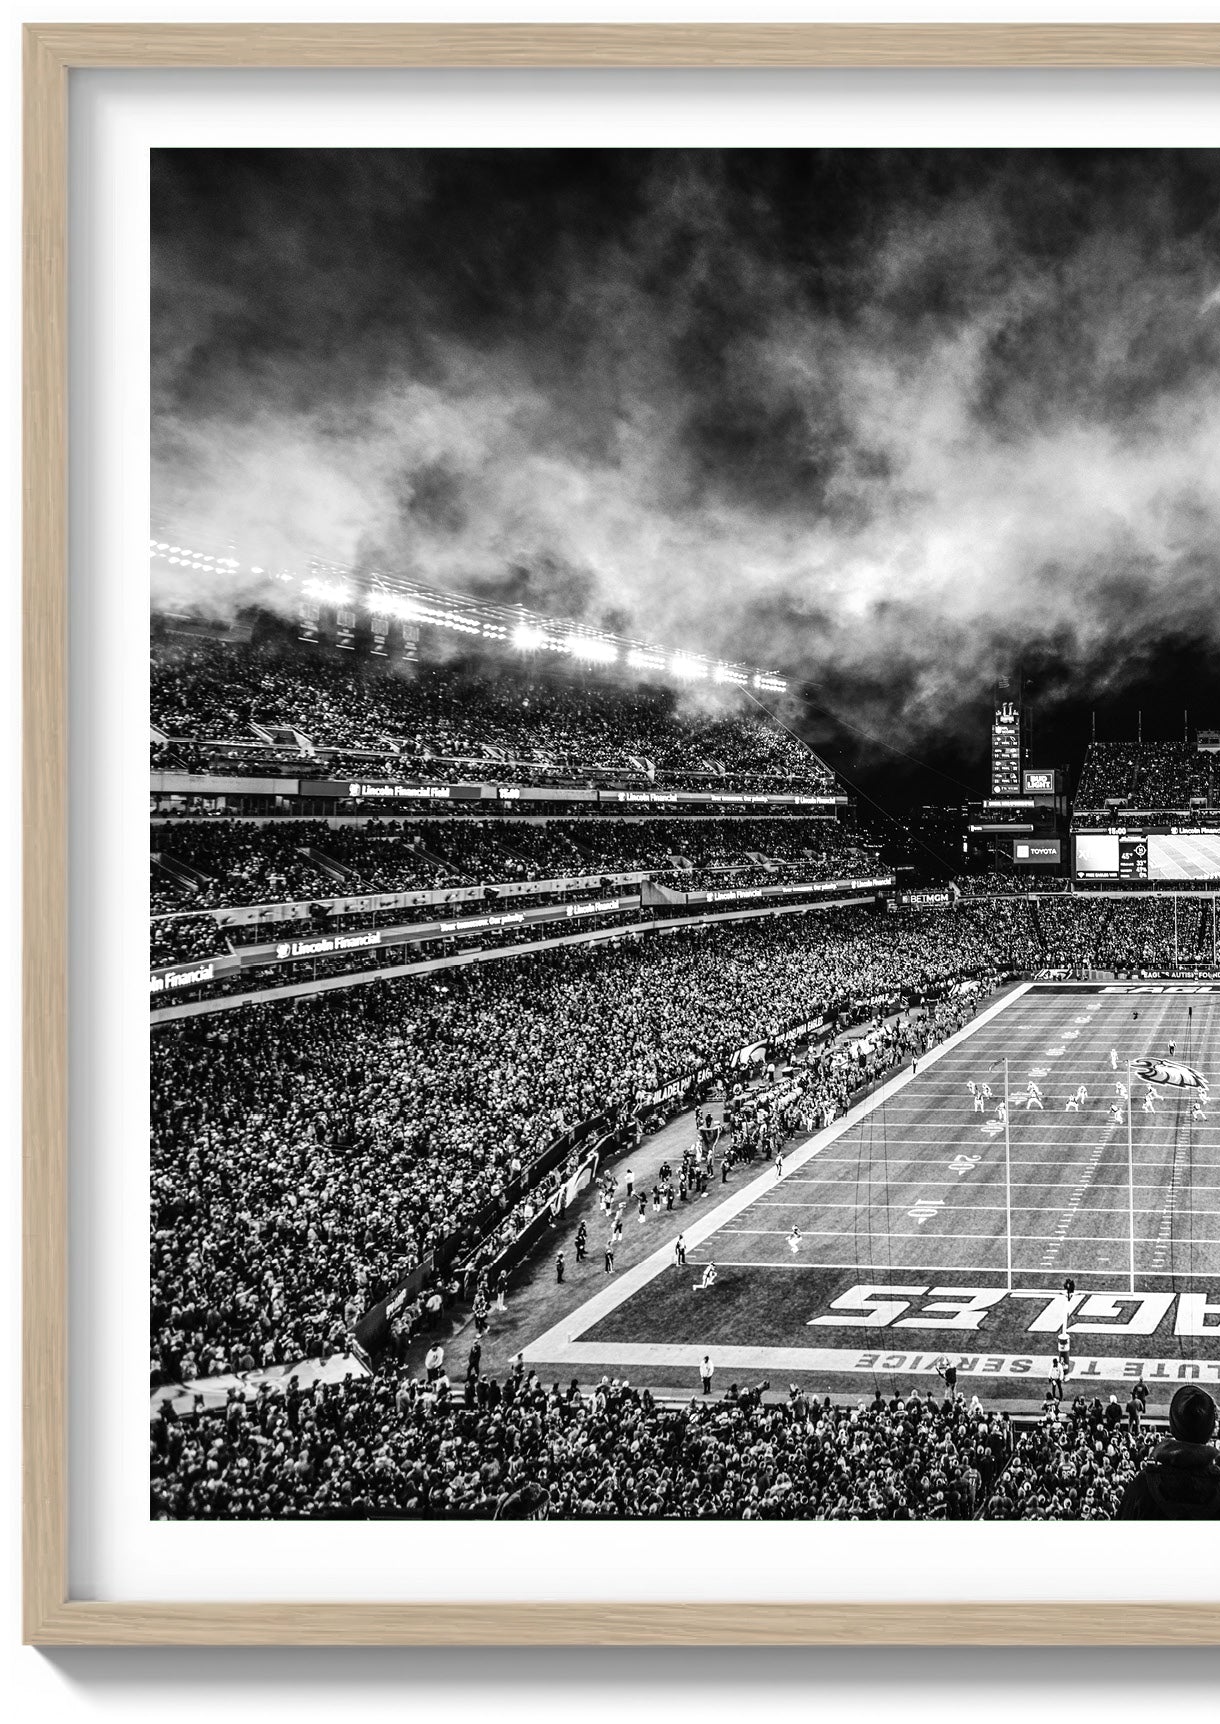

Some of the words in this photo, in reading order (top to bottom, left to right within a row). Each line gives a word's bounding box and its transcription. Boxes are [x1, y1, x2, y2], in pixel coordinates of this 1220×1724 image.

[361, 785, 394, 795] Lincoln
[394, 785, 430, 797] Financial
[430, 786, 450, 797] Field
[626, 793, 650, 801] Lincoln
[650, 793, 677, 801] Financial
[1179, 826, 1200, 834] Lincoln
[714, 891, 737, 901] Lincoln
[737, 889, 762, 899] Financial
[910, 894, 949, 903] BETMGM
[573, 903, 595, 915] Lincoln
[594, 900, 619, 912] Financial
[292, 941, 334, 956] Lincoln
[334, 933, 381, 949] Financial
[164, 964, 214, 989] Financial
[854, 1353, 1034, 1374] SERVICE
